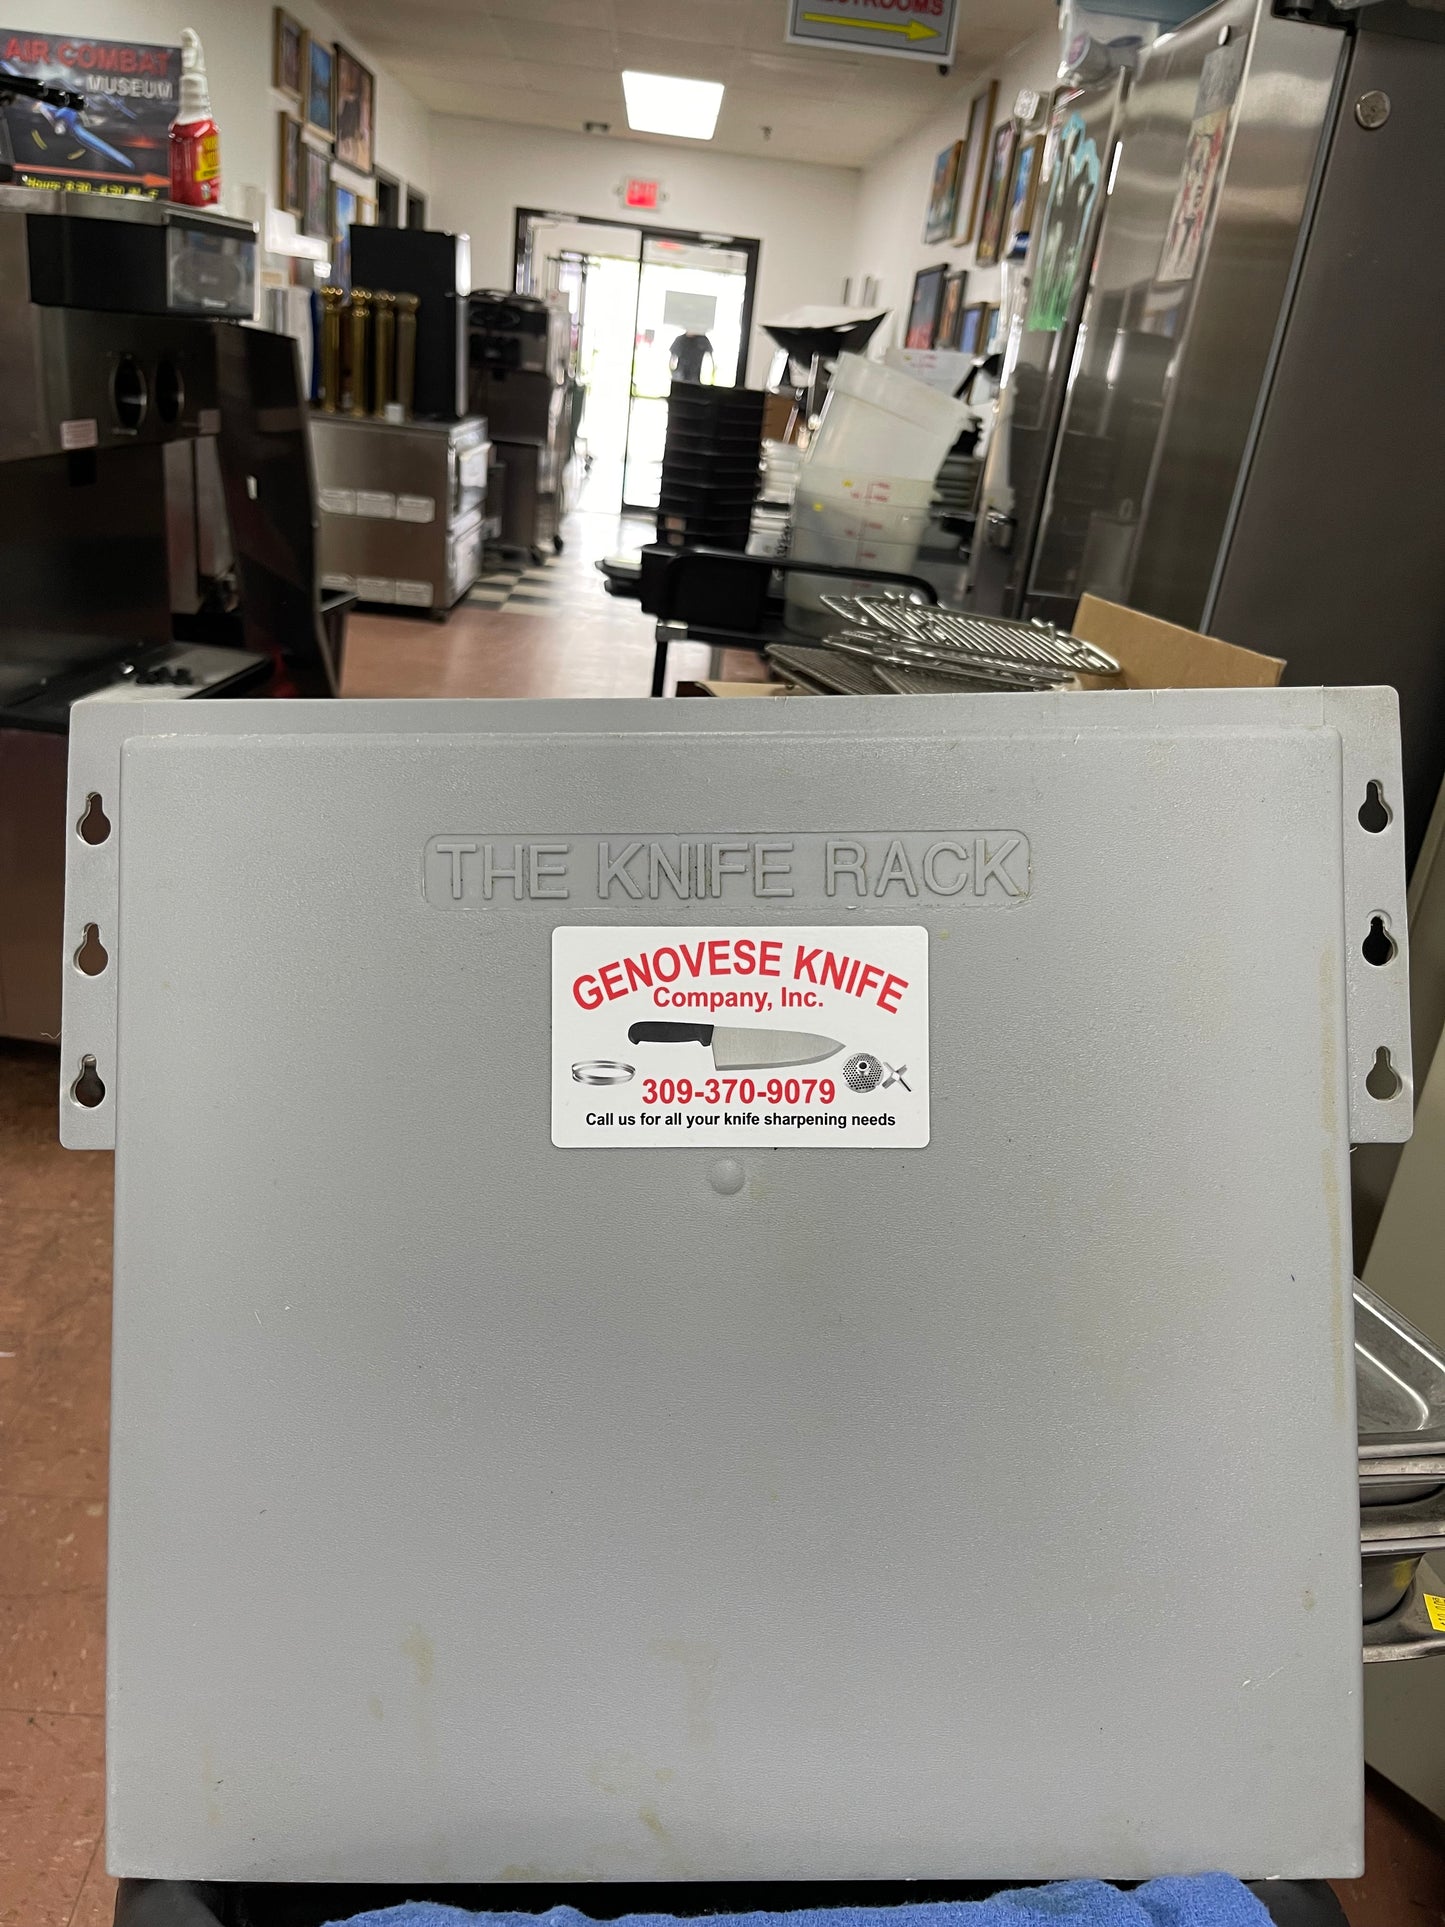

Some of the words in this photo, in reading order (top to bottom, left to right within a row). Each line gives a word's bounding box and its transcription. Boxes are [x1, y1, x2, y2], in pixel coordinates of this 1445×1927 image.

[4, 38, 50, 63] AIR
[57, 43, 170, 76] COMBAT
[86, 74, 173, 99] MUSEUM
[436, 843, 568, 899] THE
[599, 842, 794, 898] KNIFE
[825, 839, 1021, 897] RACK
[573, 939, 783, 1010] GENOVESE
[793, 944, 909, 1015] KNIFE
[652, 986, 773, 1013] Company,
[780, 986, 824, 1007] Inc.
[641, 1078, 836, 1105] 309-370-9079
[585, 1112, 614, 1126] Call
[618, 1115, 636, 1126] us
[640, 1112, 661, 1126] for
[664, 1112, 682, 1126] all
[686, 1115, 721, 1129] your
[724, 1112, 760, 1126] knife
[764, 1112, 847, 1129] sharpening
[851, 1112, 896, 1126] needs
